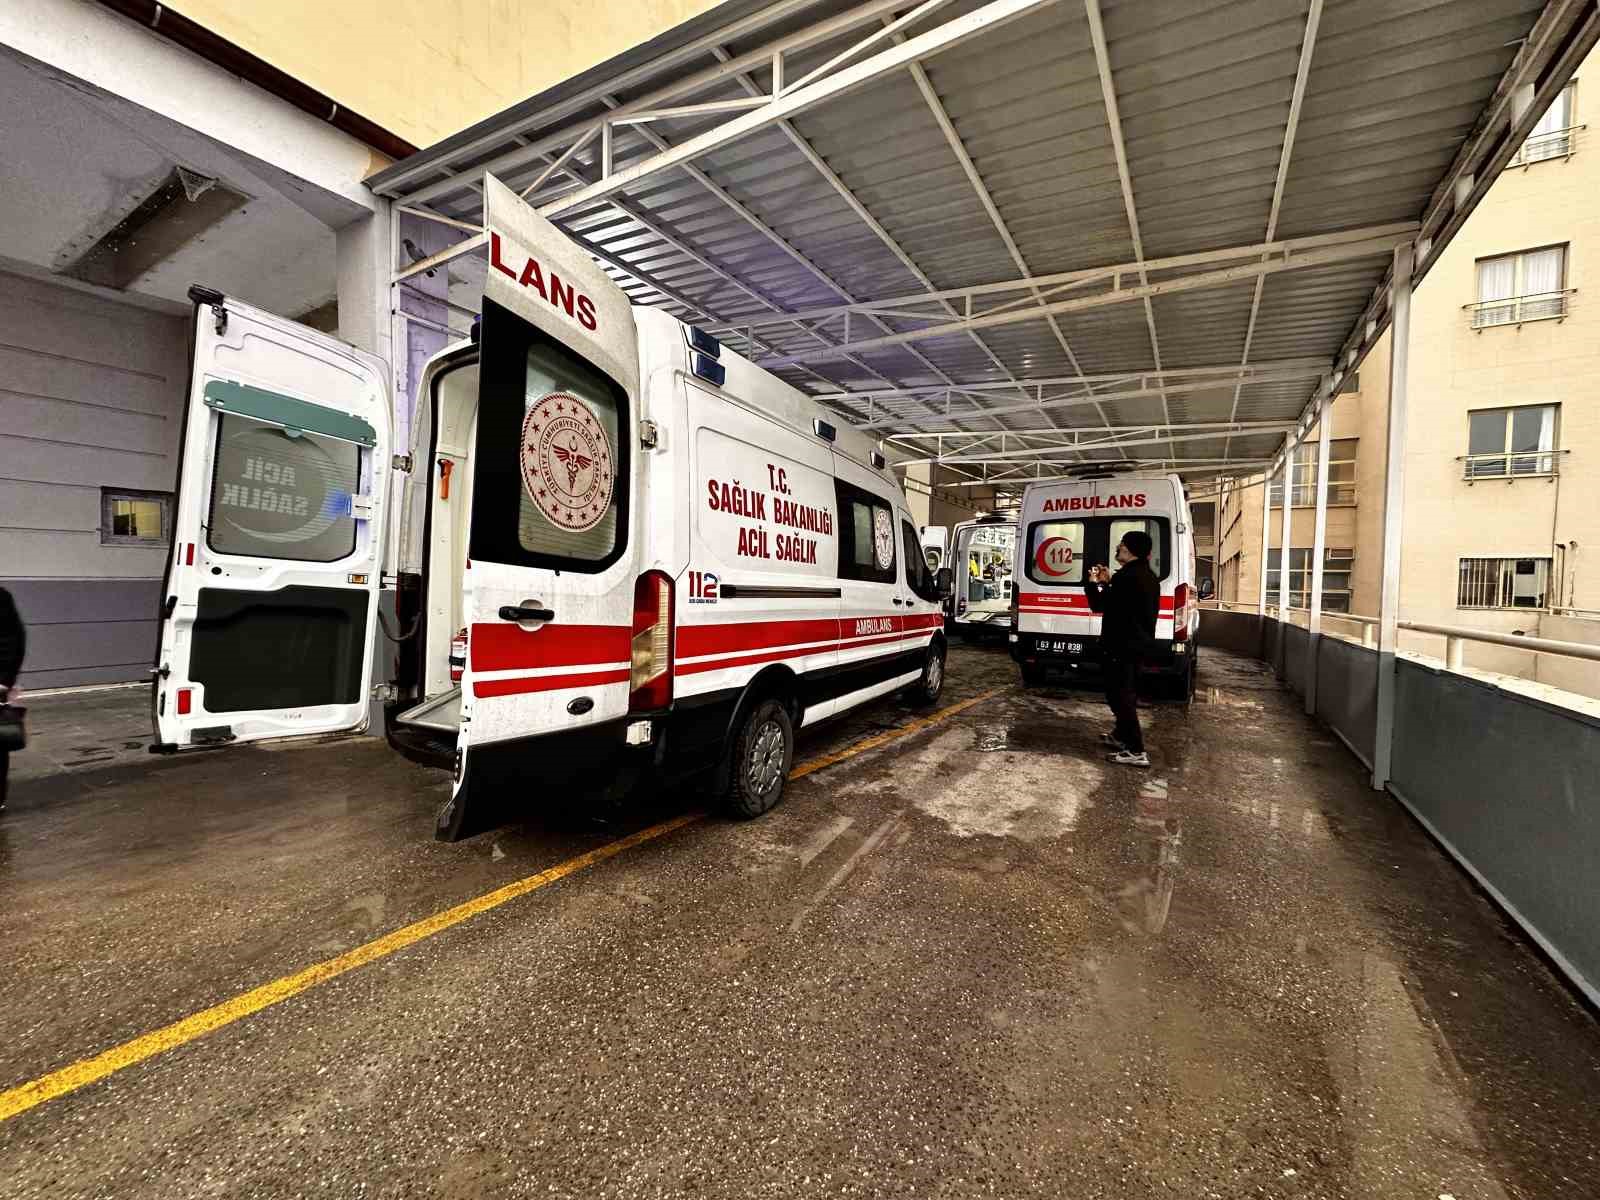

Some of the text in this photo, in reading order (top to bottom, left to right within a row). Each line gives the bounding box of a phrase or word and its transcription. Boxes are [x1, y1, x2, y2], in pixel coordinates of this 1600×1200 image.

[491, 231, 597, 331] LANS
[767, 463, 792, 496] T.C.
[707, 478, 833, 537] SAĞLIK BAKANLIĞI
[1042, 493, 1147, 513] AMBULANS
[737, 525, 817, 565] ACİL SAĞLIK
[1050, 547, 1073, 565] 112
[688, 570, 718, 598] 112
[855, 617, 892, 636] AMBULANS
[1053, 641, 1066, 650] AAT
